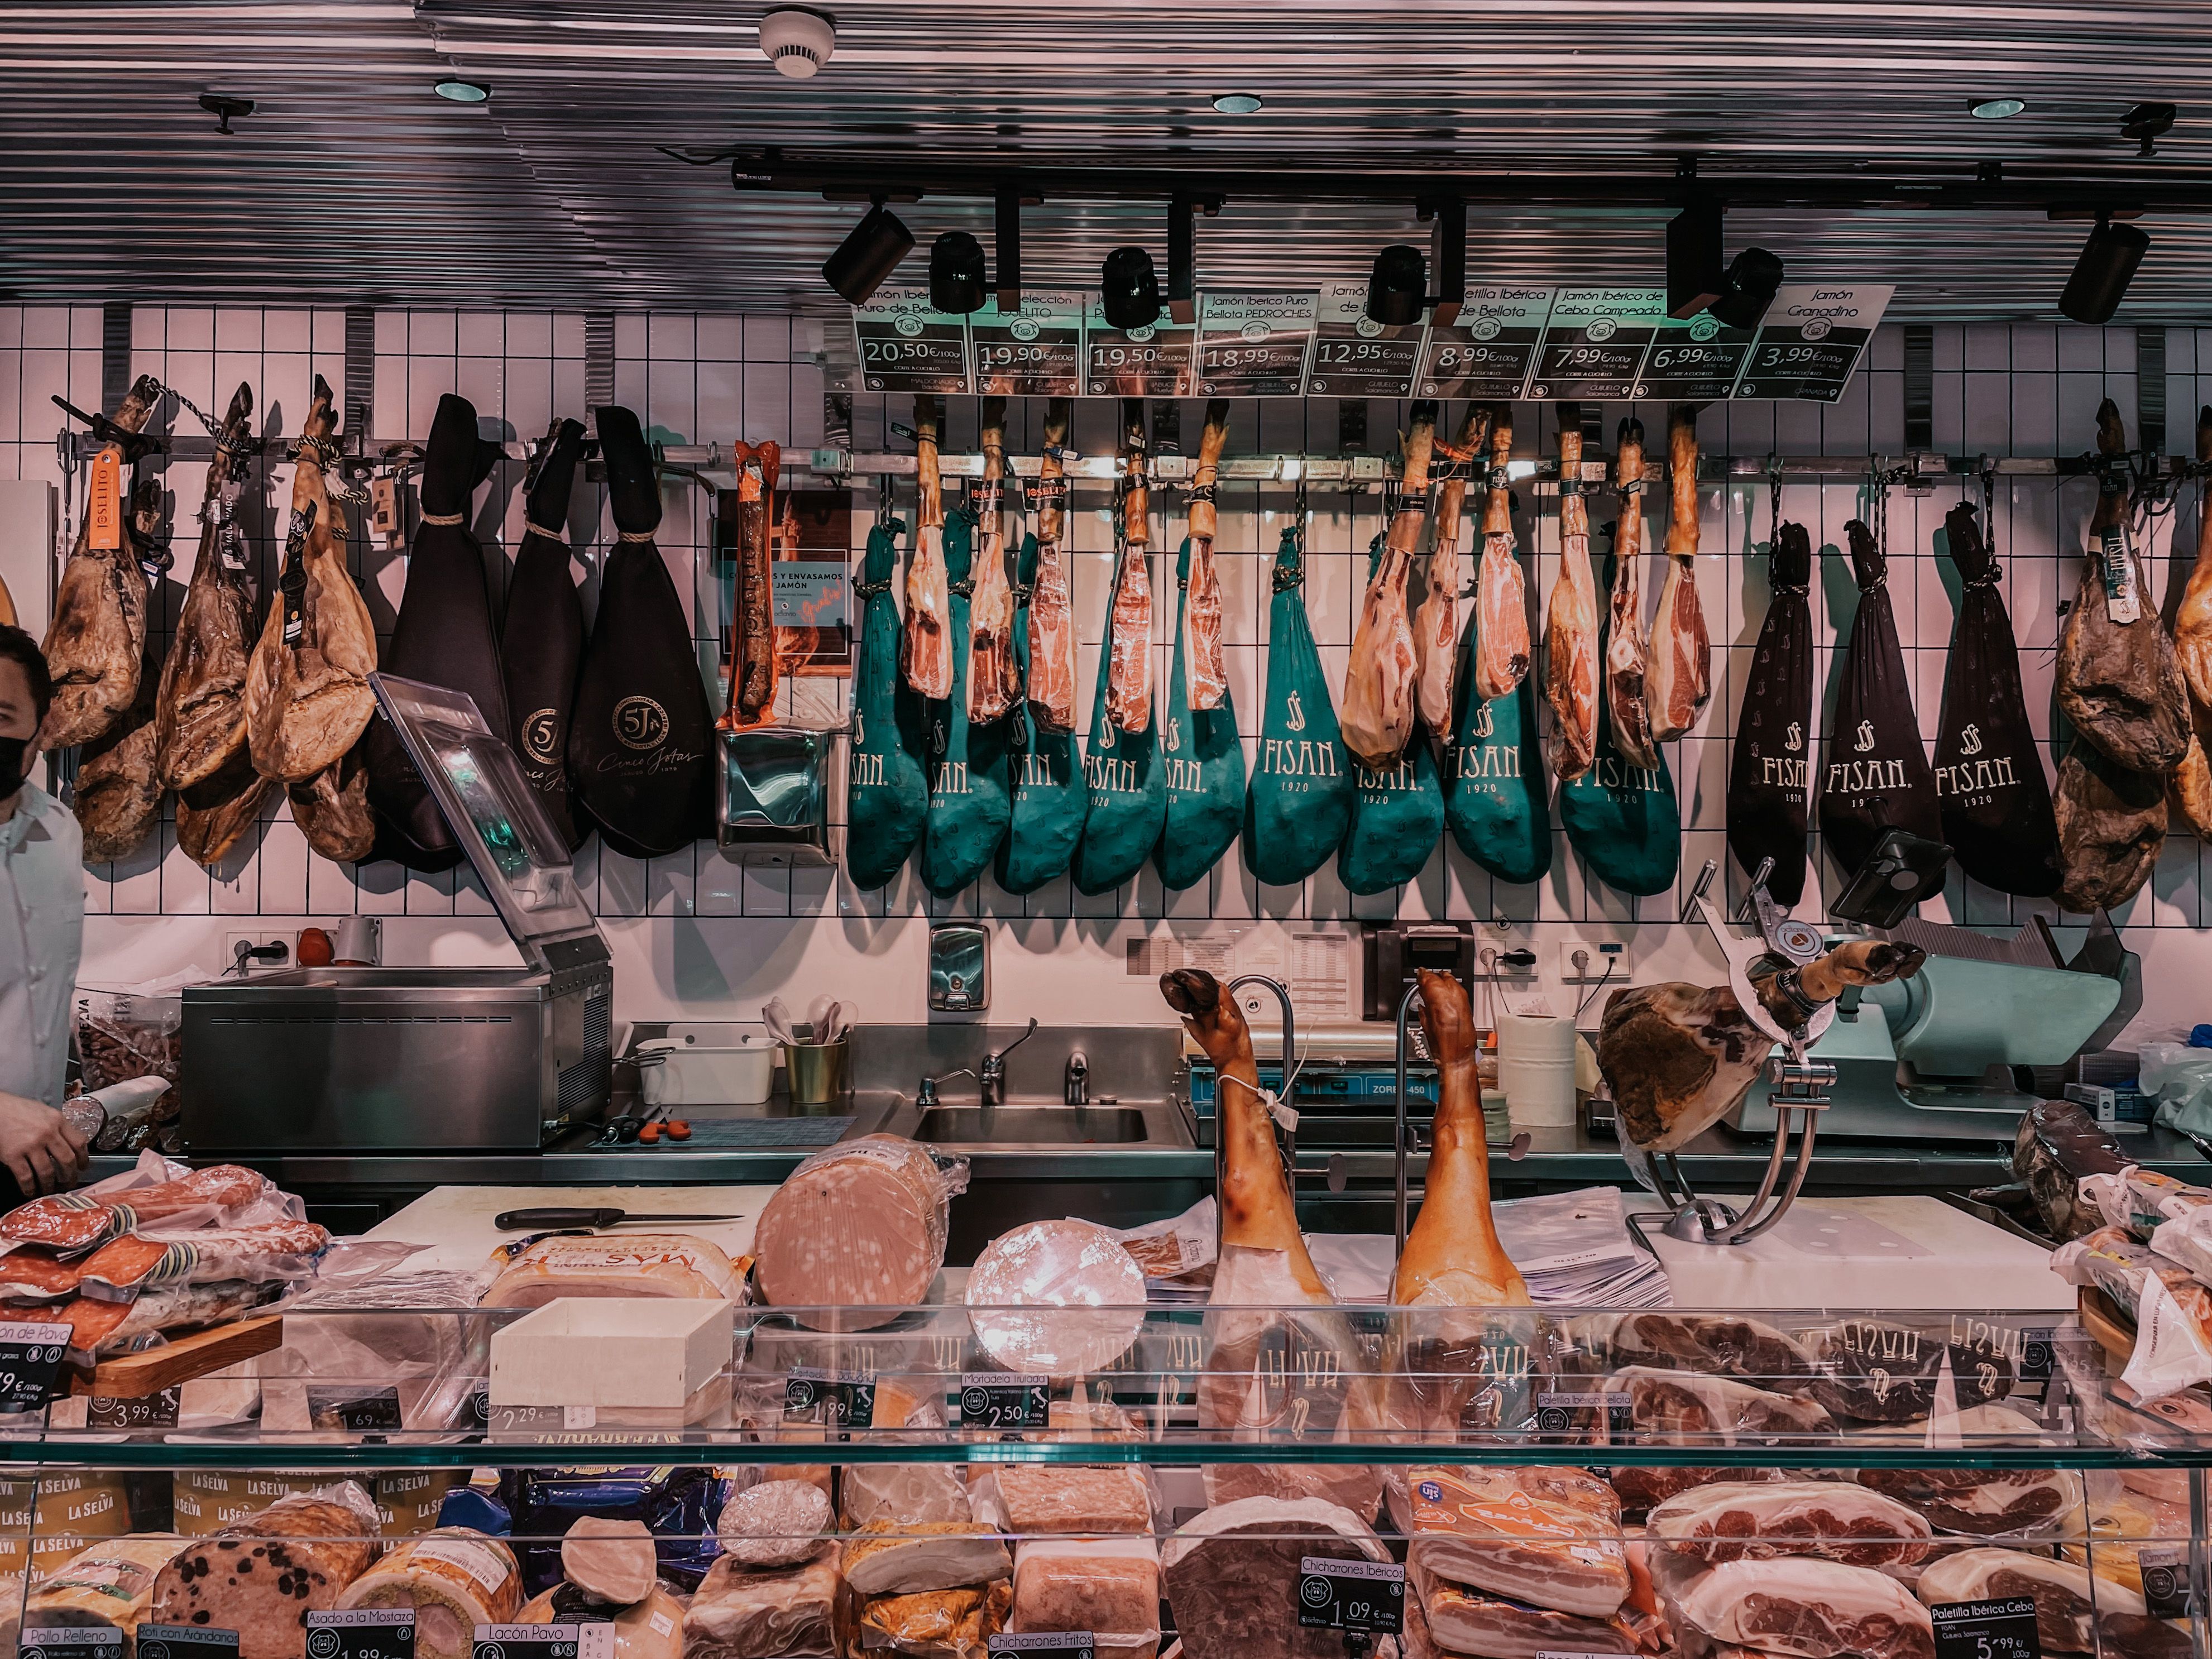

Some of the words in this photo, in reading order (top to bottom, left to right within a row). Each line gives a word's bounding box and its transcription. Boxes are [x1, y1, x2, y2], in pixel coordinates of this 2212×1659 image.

[872, 290, 900, 299] món
[904, 290, 930, 299] Ibér
[1021, 295, 1071, 304] elección
[1212, 296, 1243, 306] Jamón
[1286, 295, 1308, 305] Puro
[1465, 288, 1496, 299] etilla
[1500, 288, 1546, 299] Ibérica
[1562, 291, 1598, 301] Jamón
[1602, 291, 1643, 301] Ibérico
[1646, 291, 1663, 301] de
[1811, 289, 1852, 301] Jamón
[890, 304, 908, 313] de
[1206, 310, 1242, 318] Bellota
[1246, 309, 1311, 318] PEDROCHES
[1340, 301, 1358, 313] de
[1480, 305, 1526, 317] Bellota
[1555, 305, 1589, 315] Cebo
[1788, 305, 1858, 317] Granadino
[776, 581, 807, 589] JAMÓN
[1264, 739, 1337, 776] FISAN
[1443, 745, 1521, 779] FISAN
[850, 754, 884, 786] SAN
[1006, 754, 1052, 786] SAN
[1164, 757, 1202, 792] SAN
[1826, 759, 1908, 793] FISAN
[1935, 756, 2017, 797] FISAN
[932, 762, 968, 793] SAN
[1281, 782, 1309, 793] 1920
[1467, 784, 1497, 794] 1920
[1090, 797, 1109, 807] 1920
[1363, 795, 1389, 805] 1920
[1607, 793, 1638, 804] 1920
[1964, 794, 1993, 808] 1920
[17, 1326, 35, 1339] de
[37, 1327, 70, 1340] Pavo
[965, 1374, 1011, 1384] Mortadela
[46, 1477, 82, 1494] SELVA
[193, 1473, 201, 1487] LA
[203, 1474, 229, 1492] SELVA
[248, 1480, 258, 1494] LA
[260, 1480, 290, 1495] SELVA
[383, 1479, 394, 1494] LA
[397, 1475, 430, 1492] SELVA
[68, 1506, 82, 1521] LA
[84, 1496, 114, 1517] SELVA
[180, 1498, 201, 1517] SELVA
[218, 1506, 228, 1521] LA
[418, 1503, 430, 1518] LA
[2, 1511, 14, 1526] LA
[34, 1539, 46, 1553] LA
[48, 1538, 84, 1552] SELVA
[1303, 1559, 1363, 1575] Chicharrones
[1367, 1564, 1403, 1578] Ibéricos
[309, 1612, 342, 1624] Asado
[356, 1612, 366, 1623] la
[369, 1610, 414, 1623] Mostaza
[1932, 1606, 1970, 1620] Paletilla
[1971, 1603, 2005, 1615] Ibérica
[2007, 1600, 2034, 1613] Cebo
[31, 1629, 60, 1643] Pollo
[64, 1629, 107, 1643] Relleno
[161, 1629, 180, 1639] con
[184, 1628, 238, 1644] Arándanos
[489, 1626, 528, 1641] Lacón
[532, 1625, 564, 1640] Pavo
[990, 1636, 1061, 1648] Chicharrones
[1065, 1632, 1092, 1646] Fritos
